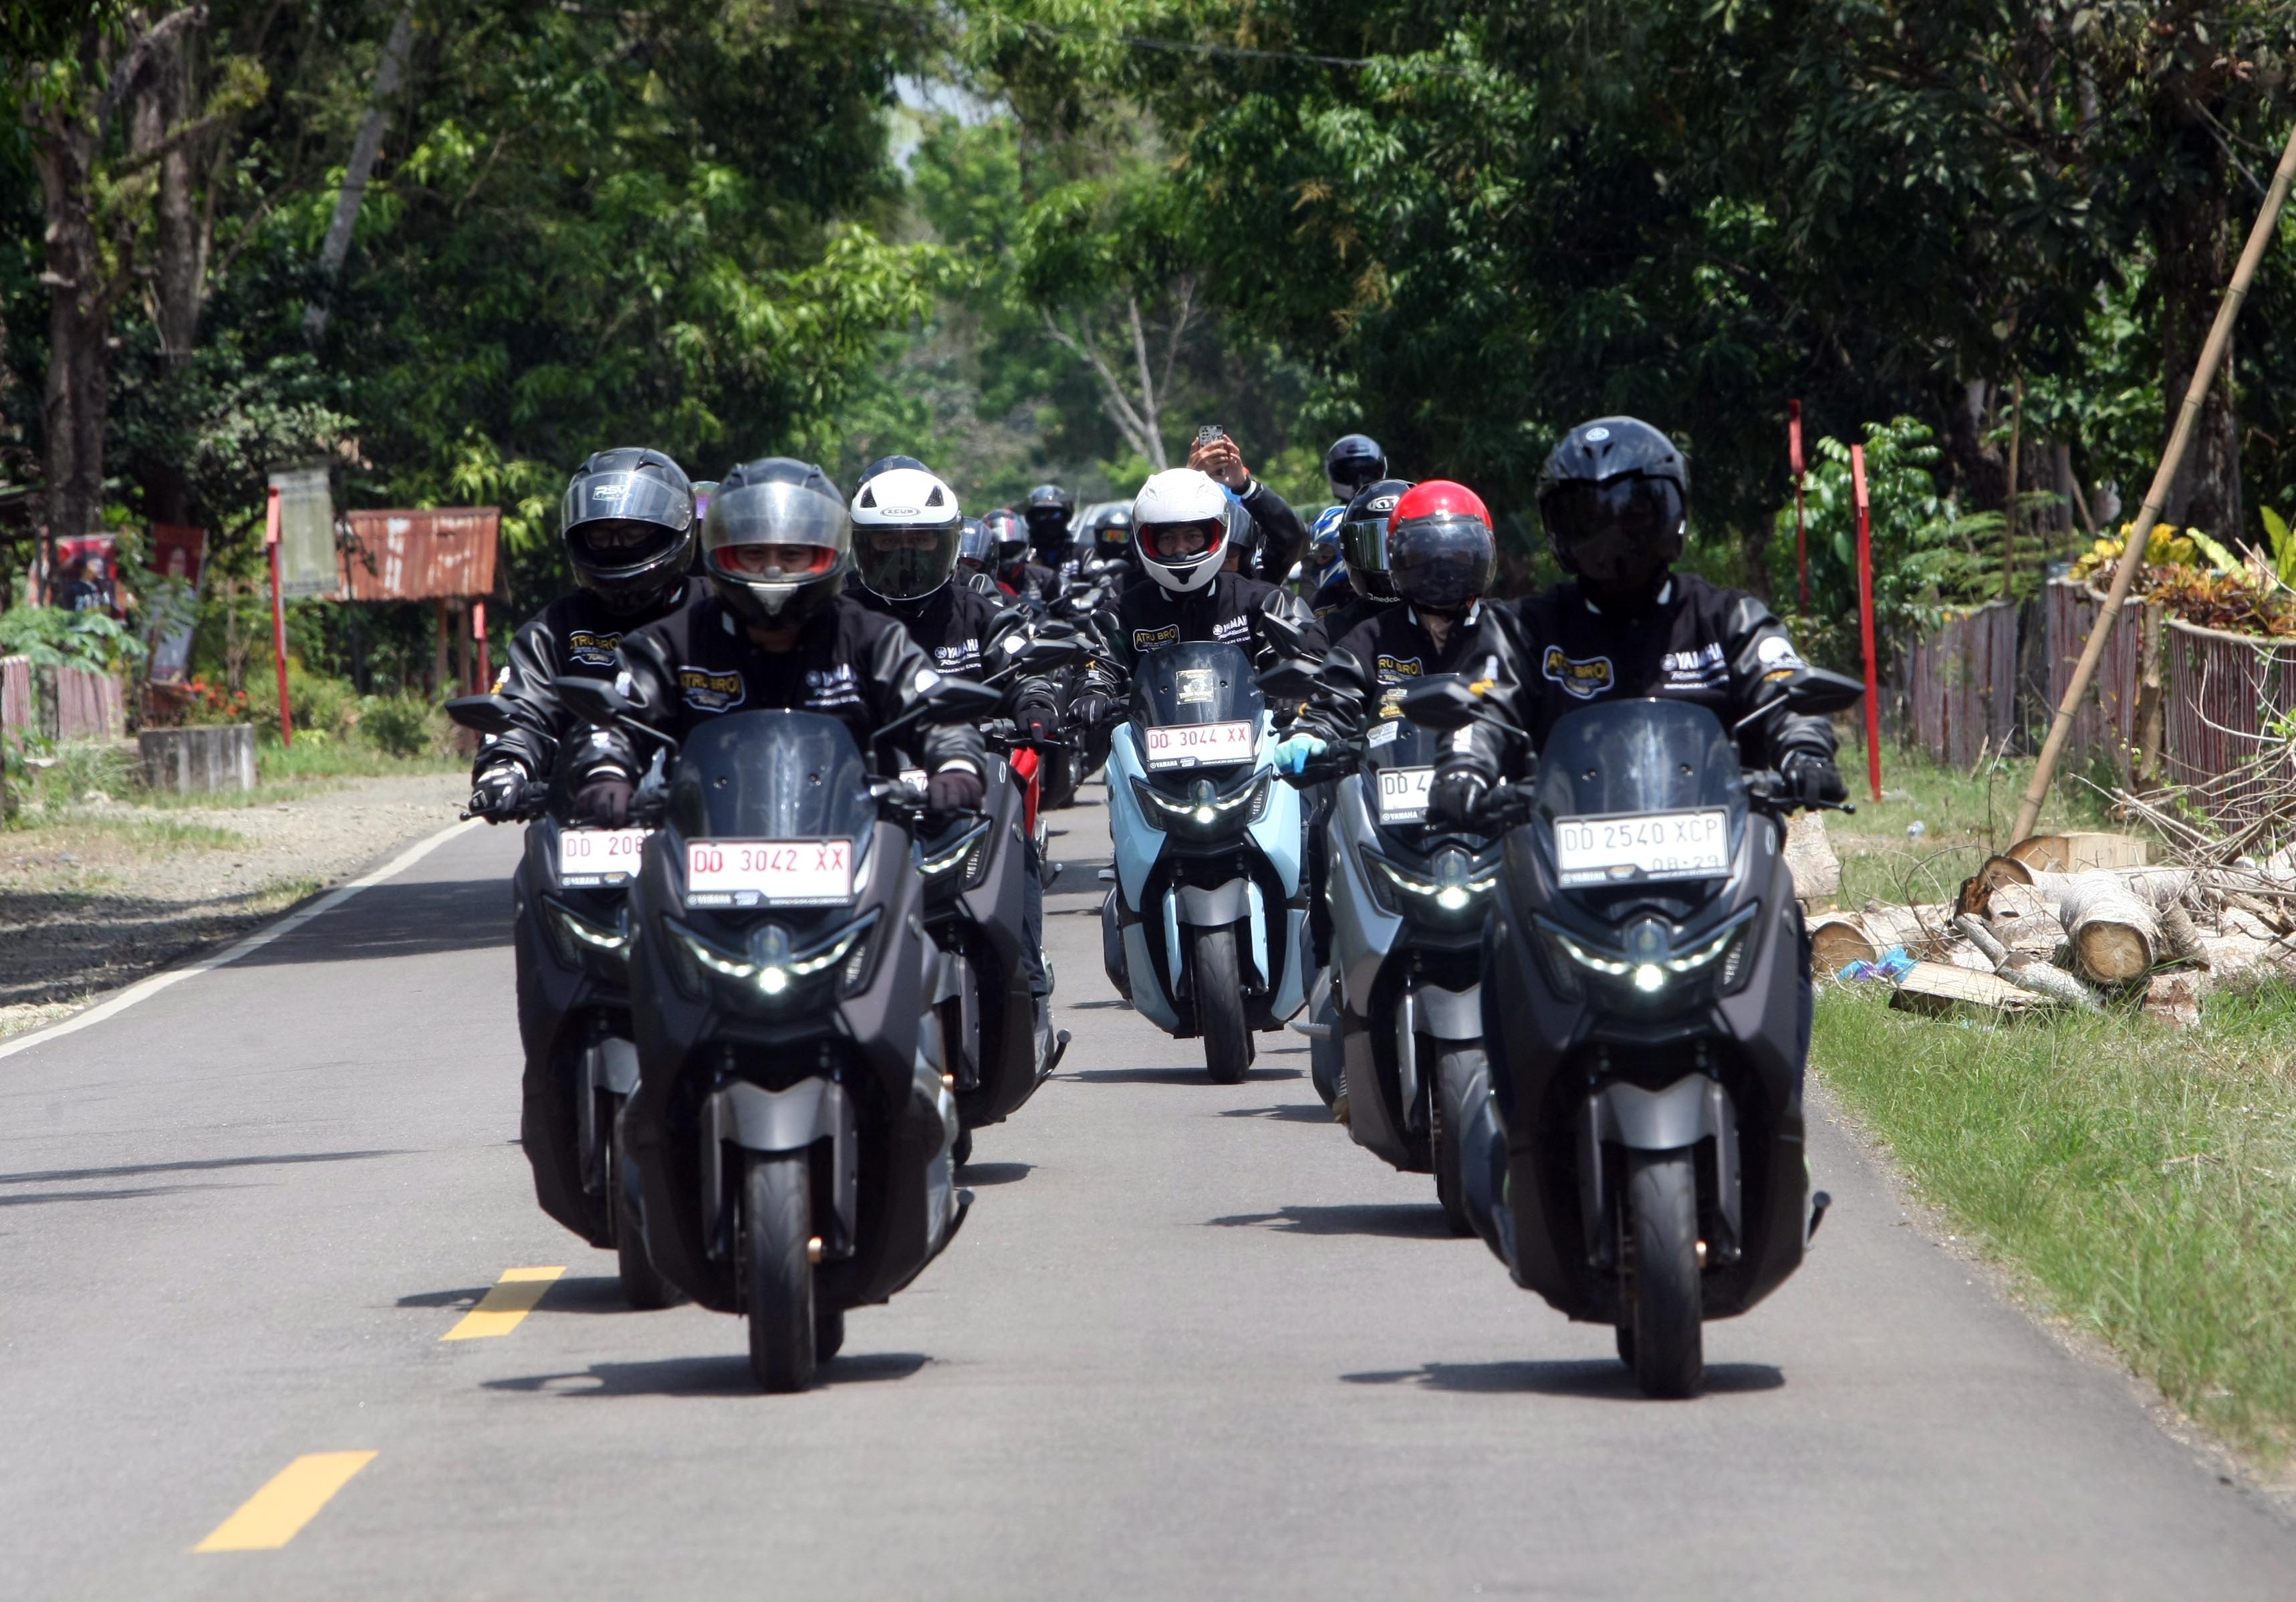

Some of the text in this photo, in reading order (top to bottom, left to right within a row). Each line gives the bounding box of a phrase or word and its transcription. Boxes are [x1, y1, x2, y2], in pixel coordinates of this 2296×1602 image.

[1136, 632, 1156, 645] ATRU
[1378, 658, 1394, 668] RU
[1150, 726, 1247, 749] DD 3044 XX
[1384, 774, 1427, 795] DD 4
[1390, 810, 1418, 821] YAMAHA
[1564, 818, 1718, 851] DD 2540 XCP
[565, 837, 591, 857] DD
[694, 847, 843, 873] DD 3042 XX
